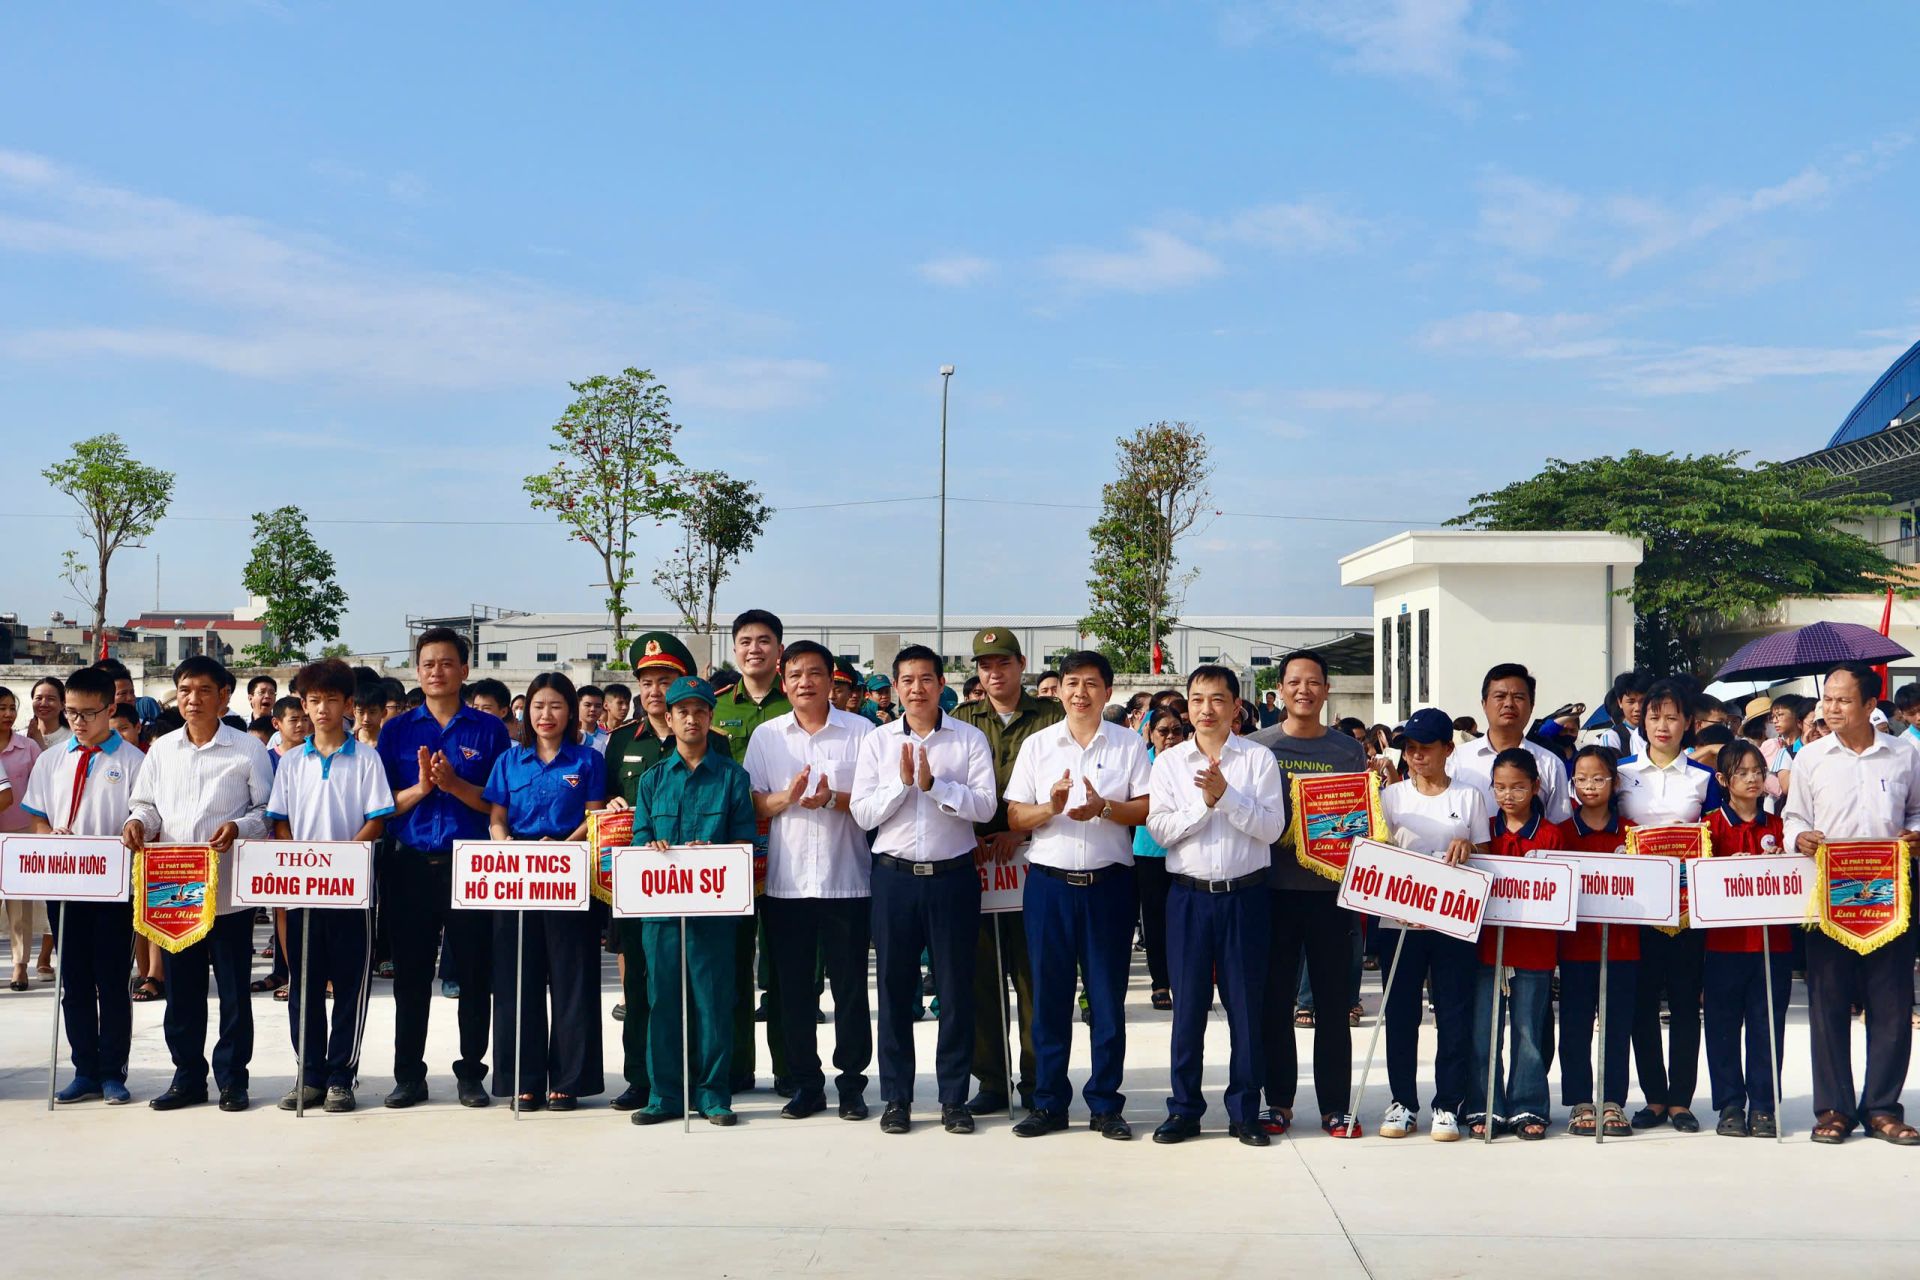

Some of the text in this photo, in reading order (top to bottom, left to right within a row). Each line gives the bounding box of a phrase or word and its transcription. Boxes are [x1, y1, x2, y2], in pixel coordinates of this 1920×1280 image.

[19, 851, 106, 875] THÔN NHÂN HƯNG
[276, 848, 332, 868] THÔN
[471, 851, 571, 873] ĐOÀN TNCS
[251, 872, 355, 896] ĐÔNG PHAN
[465, 875, 576, 900] HỒ CHÍ MINH
[641, 864, 726, 898] QUÂN SỰ
[994, 865, 1018, 890] AN
[1491, 877, 1556, 903] HƯỢNG ĐÁP
[1581, 870, 1634, 900] THÔN ĐỤN
[1724, 867, 1802, 897] THÔN ĐỒN BỐI
[1350, 864, 1481, 923] HỘI NÔNG DÂN
